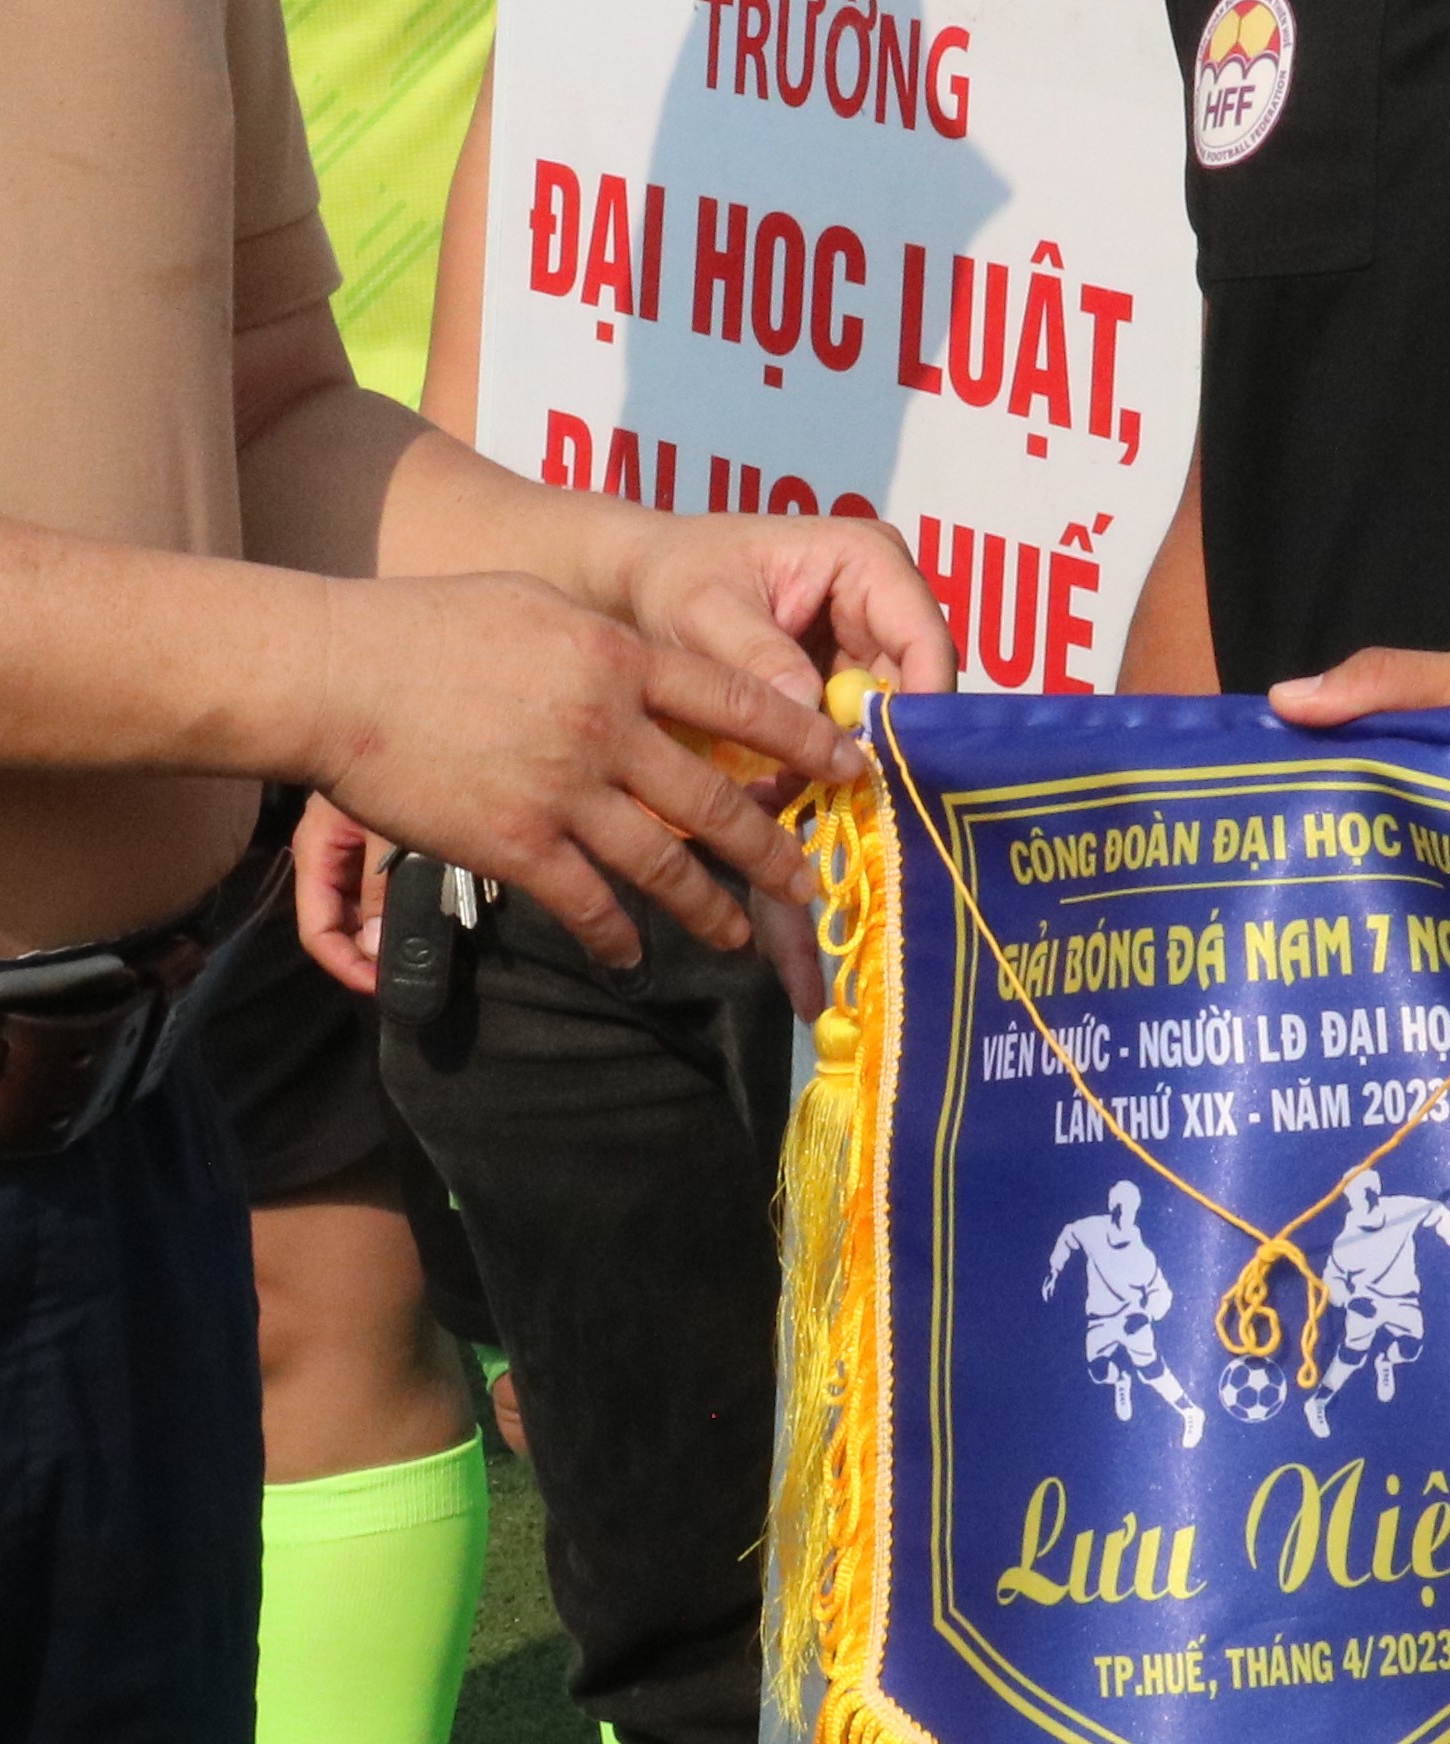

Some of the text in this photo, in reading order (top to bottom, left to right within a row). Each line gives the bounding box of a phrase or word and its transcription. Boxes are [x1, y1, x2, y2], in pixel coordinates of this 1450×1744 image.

[1202, 84, 1257, 133] HFF
[1250, 68, 1288, 144] FEDERATION
[528, 159, 1143, 468] ĐẠI HỌC LUẬT,
[918, 513, 1115, 695] HUẾ
[1010, 826, 1097, 885] CÔNG
[1104, 811, 1200, 872] ĐOÀN
[1212, 817, 1287, 871] ĐẠI
[1303, 812, 1402, 869] HỌC
[997, 920, 1058, 1002] GIẢI
[1063, 916, 1156, 994] BÓNG
[1167, 908, 1227, 990] ĐÁ
[1244, 914, 1352, 987] NAM
[1365, 913, 1391, 974] 7
[982, 1020, 1035, 1082] VIÊN
[1040, 1013, 1111, 1077] CHỨC
[1138, 1005, 1246, 1068] NGƯỜI
[1258, 1013, 1308, 1063] LĐ
[1321, 1006, 1388, 1068] ĐẠI
[1111, 1080, 1174, 1142] THỨ
[1181, 1090, 1238, 1138] XIX
[1270, 1075, 1352, 1133] NĂM
[1362, 1076, 1450, 1125] 2023
[996, 1476, 1208, 1607] Lưu
[1225, 1631, 1334, 1690] THÁNG
